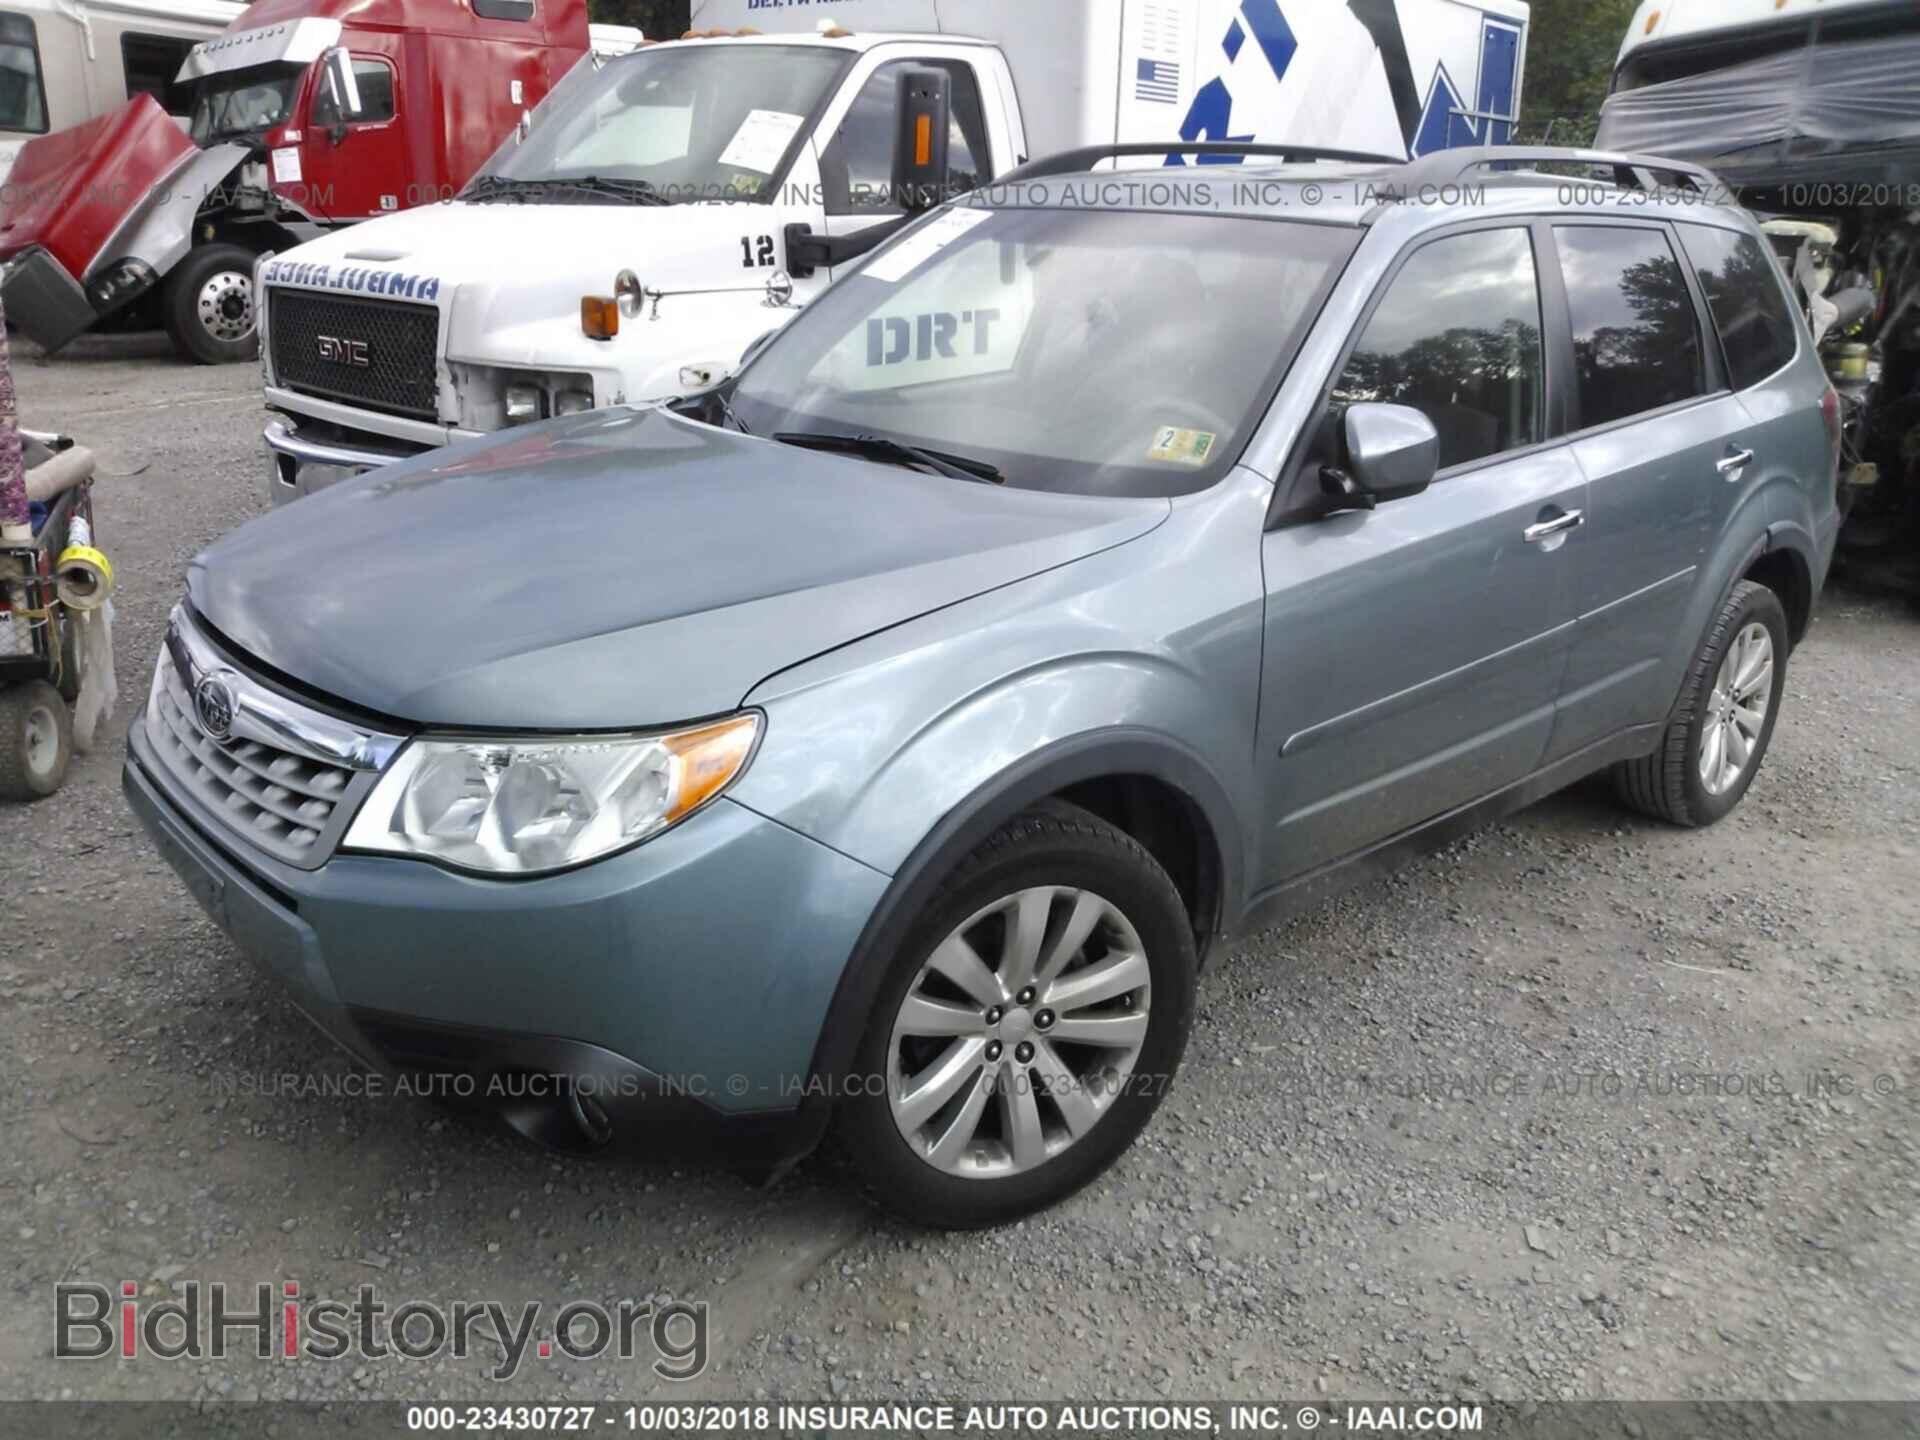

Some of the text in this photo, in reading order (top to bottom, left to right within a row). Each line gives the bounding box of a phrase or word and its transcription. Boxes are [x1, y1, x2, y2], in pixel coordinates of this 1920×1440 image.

[741, 235, 775, 267] 12
[318, 335, 369, 366] GMC
[866, 308, 1000, 367] DRT
[1161, 430, 1175, 448] 2
